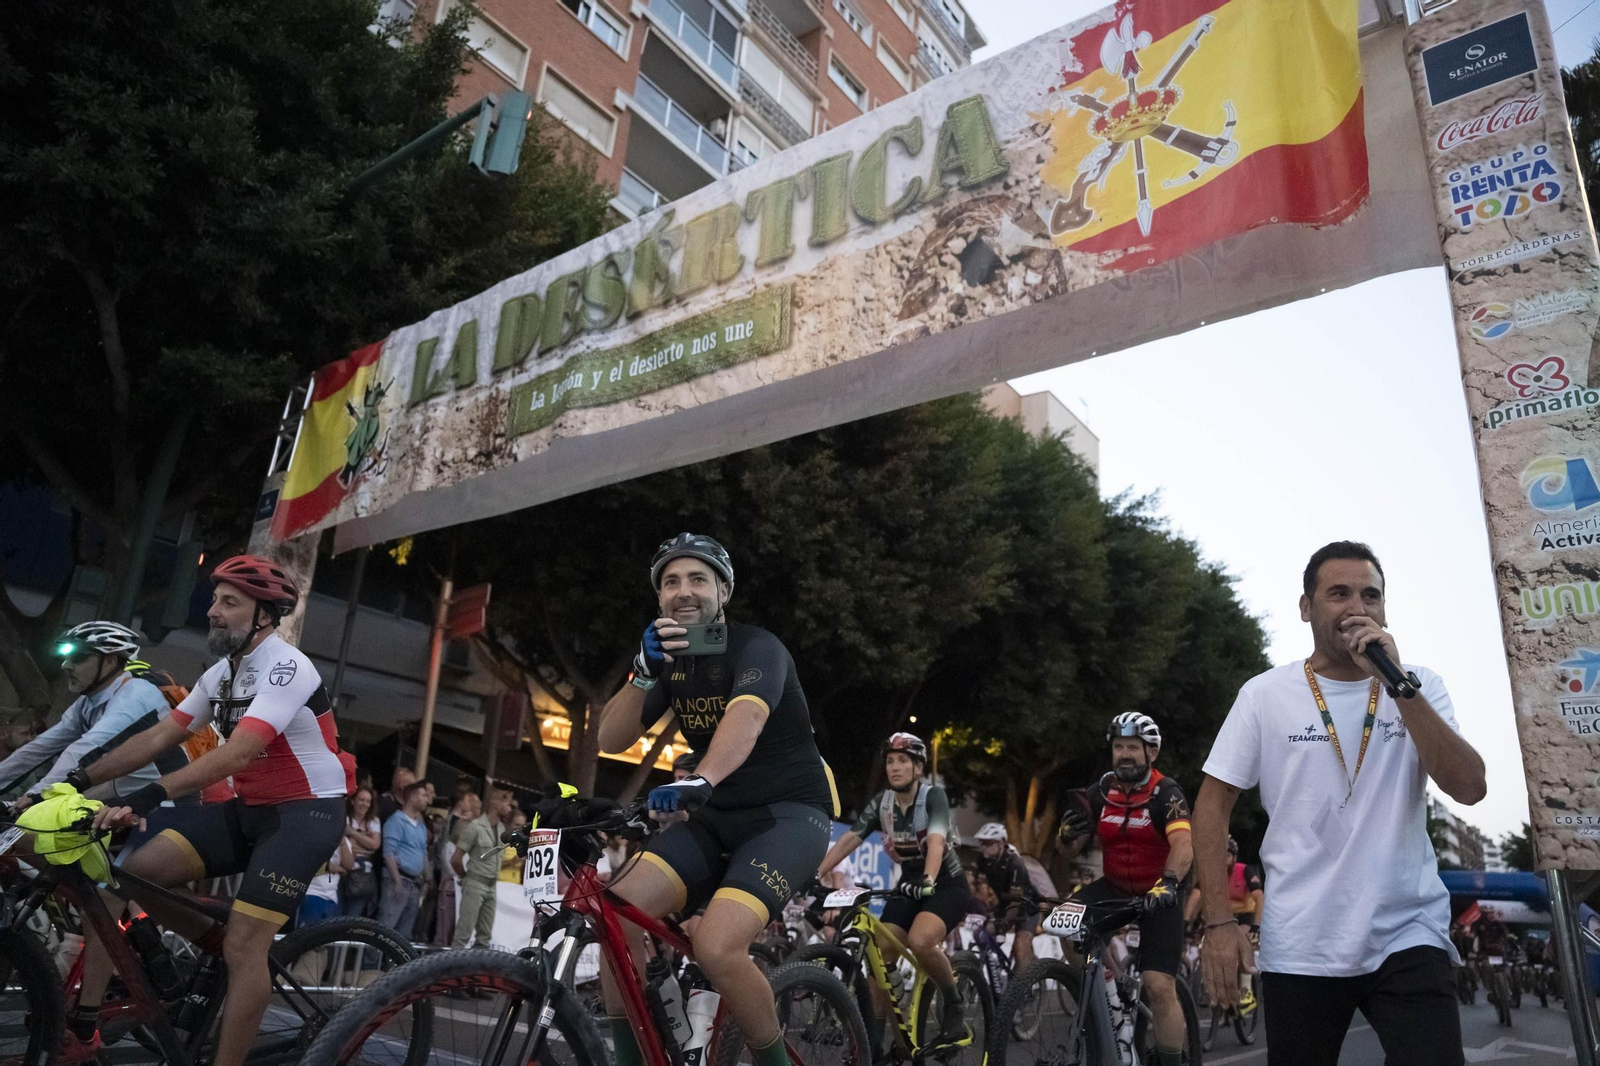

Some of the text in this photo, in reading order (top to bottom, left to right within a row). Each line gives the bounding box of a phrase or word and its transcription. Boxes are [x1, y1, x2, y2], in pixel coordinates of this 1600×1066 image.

[1449, 52, 1508, 79] SENATOR
[1437, 93, 1544, 150] Coca-Cola
[1449, 145, 1548, 182] GRUPO
[1451, 159, 1556, 204] RENTA
[1454, 181, 1561, 227] TODO
[1517, 288, 1586, 311] Andalucía
[407, 318, 477, 412] LA
[530, 390, 544, 411] La
[591, 370, 603, 391] y
[609, 360, 623, 383] el
[629, 343, 685, 377] desierto
[691, 332, 717, 356] nos
[725, 319, 754, 343] une
[1533, 515, 1600, 537] Almerí
[1523, 582, 1600, 619] UNI
[680, 714, 718, 729] TEAM
[750, 858, 768, 871] LA
[260, 868, 307, 893] LA NOITE
[269, 881, 298, 899] TEAM
[761, 871, 785, 902] TEAM
[1050, 912, 1080, 928] 6550
